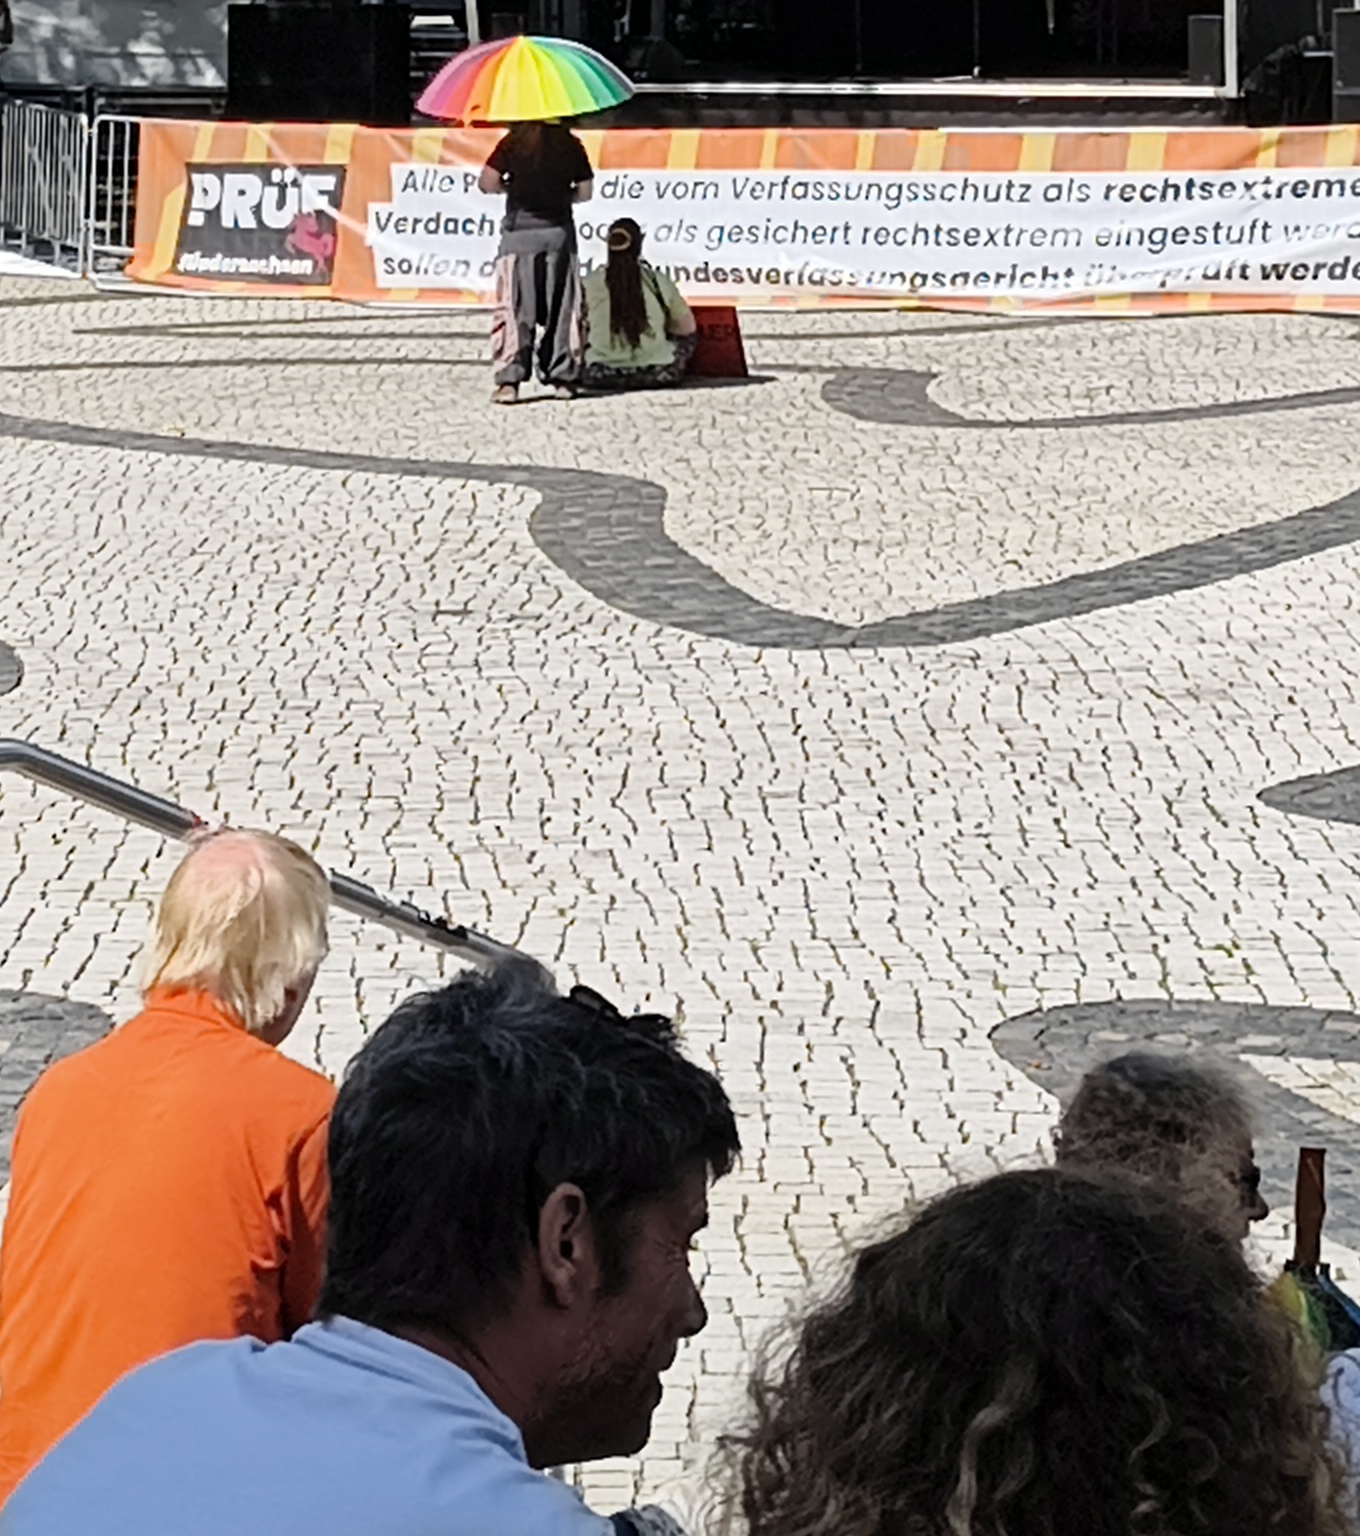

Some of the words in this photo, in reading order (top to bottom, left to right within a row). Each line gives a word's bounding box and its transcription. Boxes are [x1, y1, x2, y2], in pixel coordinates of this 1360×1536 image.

[401, 169, 455, 193] Alle
[600, 174, 644, 200] die
[732, 175, 1032, 210] Verfassungsschutz
[1043, 178, 1091, 203] als
[654, 218, 698, 244] als
[705, 219, 852, 250] gesichert
[861, 222, 1082, 247] rechtsextrem
[1095, 217, 1272, 254] eingestuft
[383, 250, 470, 278] sollen
